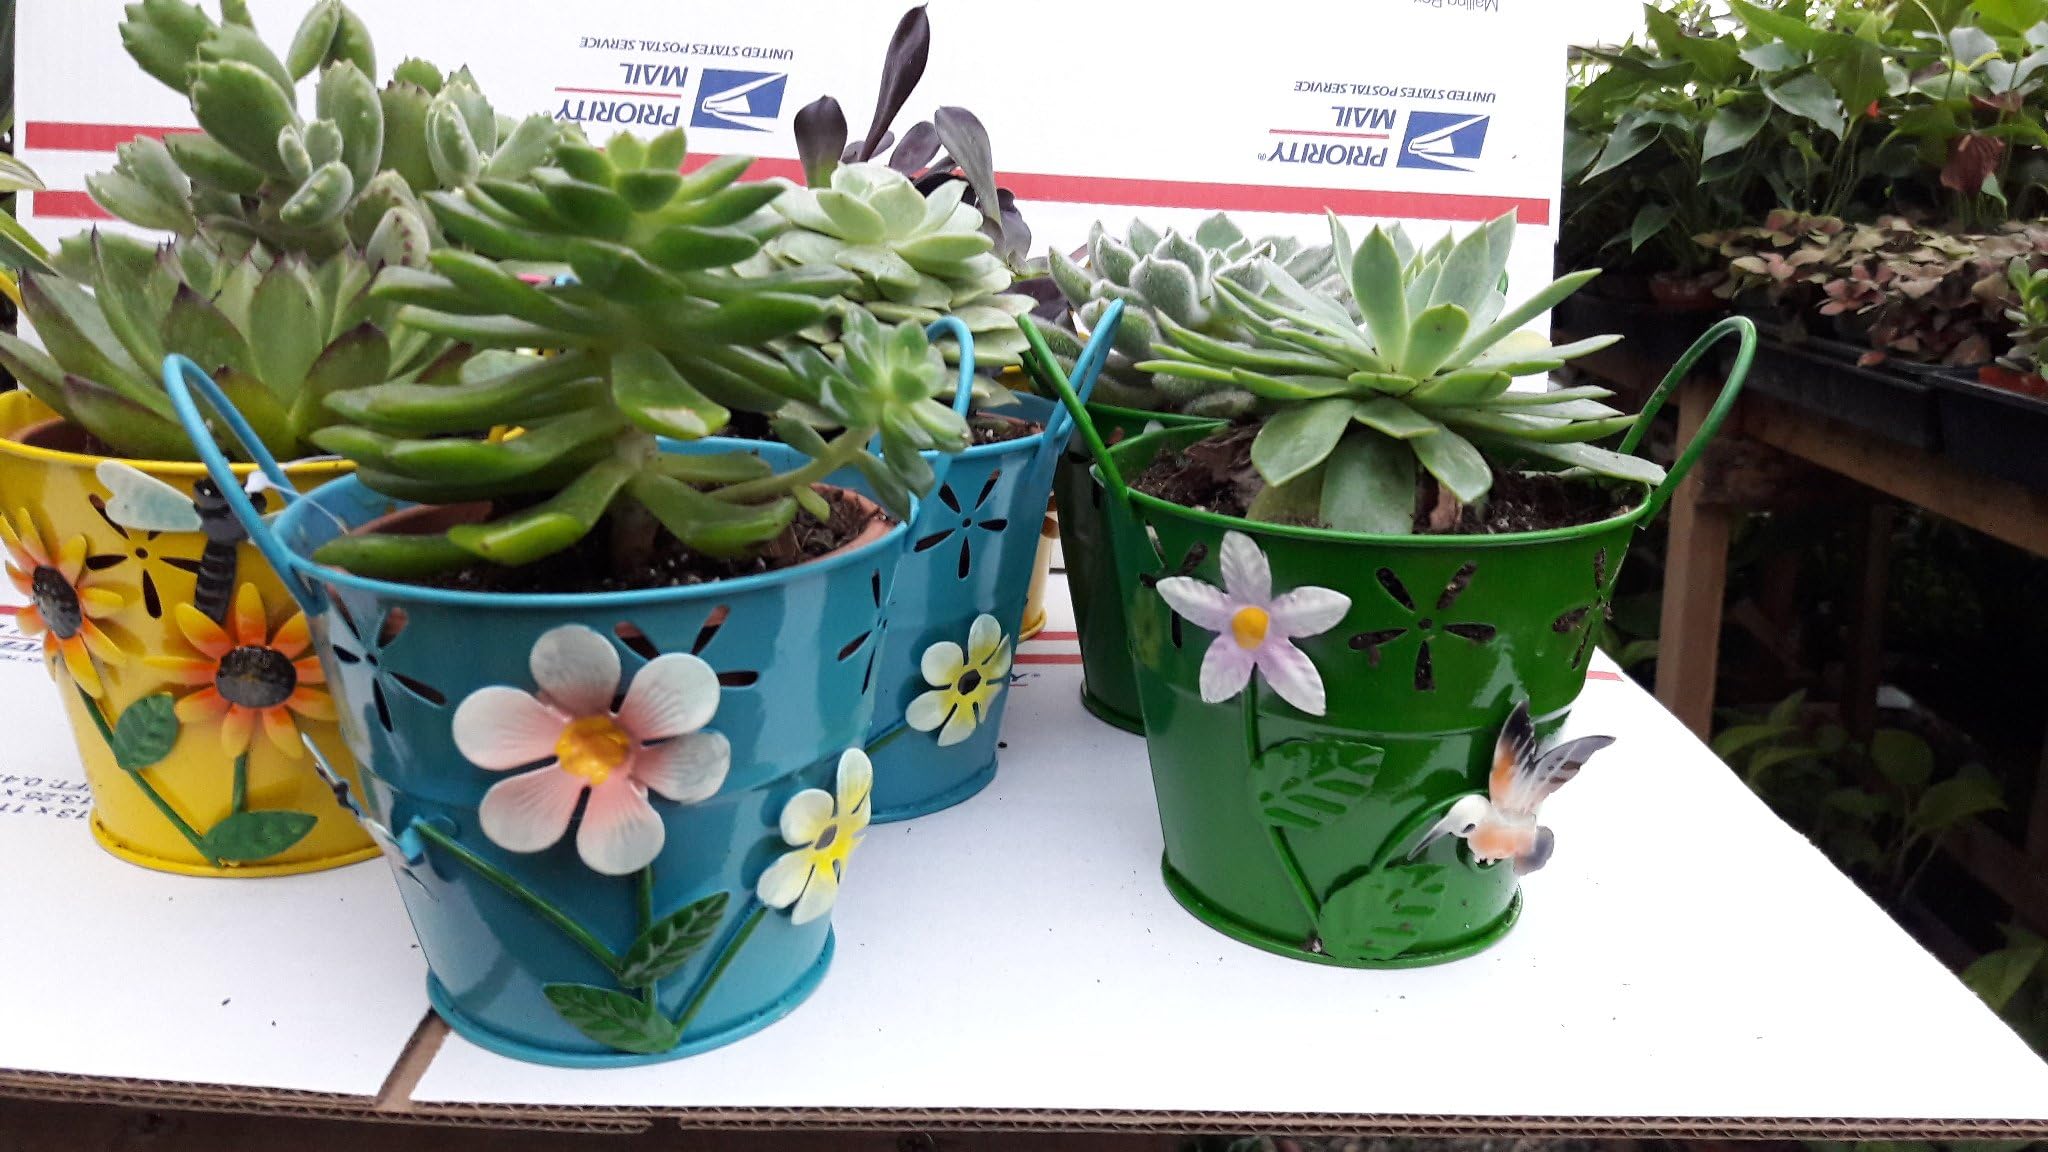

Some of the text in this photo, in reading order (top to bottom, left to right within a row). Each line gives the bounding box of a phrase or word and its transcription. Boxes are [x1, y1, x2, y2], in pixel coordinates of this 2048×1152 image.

[579, 36, 794, 60] UNITED STATES POSTAL SERVICE
[619, 62, 689, 88] MAIL
[1293, 80, 1497, 103] UNITED STATES POSTAL SERVICE
[1331, 105, 1397, 130] MAIL
